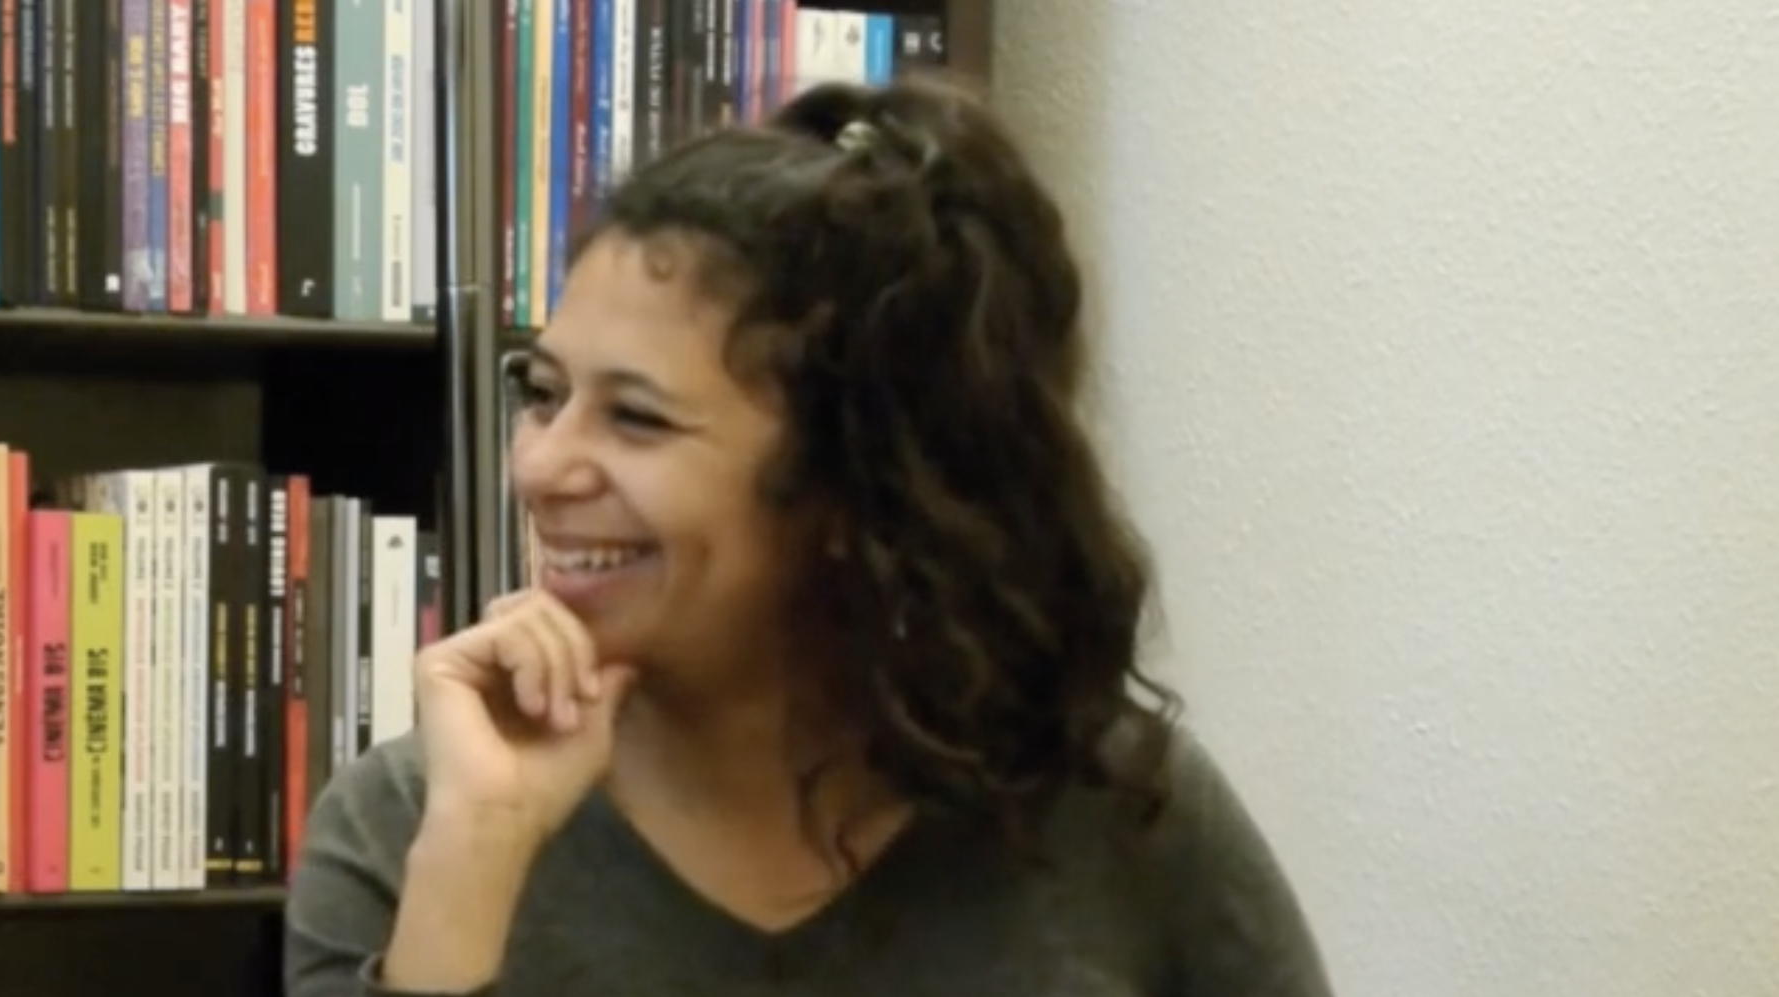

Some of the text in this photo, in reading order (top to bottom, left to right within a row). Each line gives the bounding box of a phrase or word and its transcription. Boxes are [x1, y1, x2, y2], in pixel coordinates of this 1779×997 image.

[295, 46, 317, 155] GRAVURES
[44, 643, 66, 677] BIS
[88, 648, 110, 678] BIS
[87, 683, 109, 754] CINÉMA
